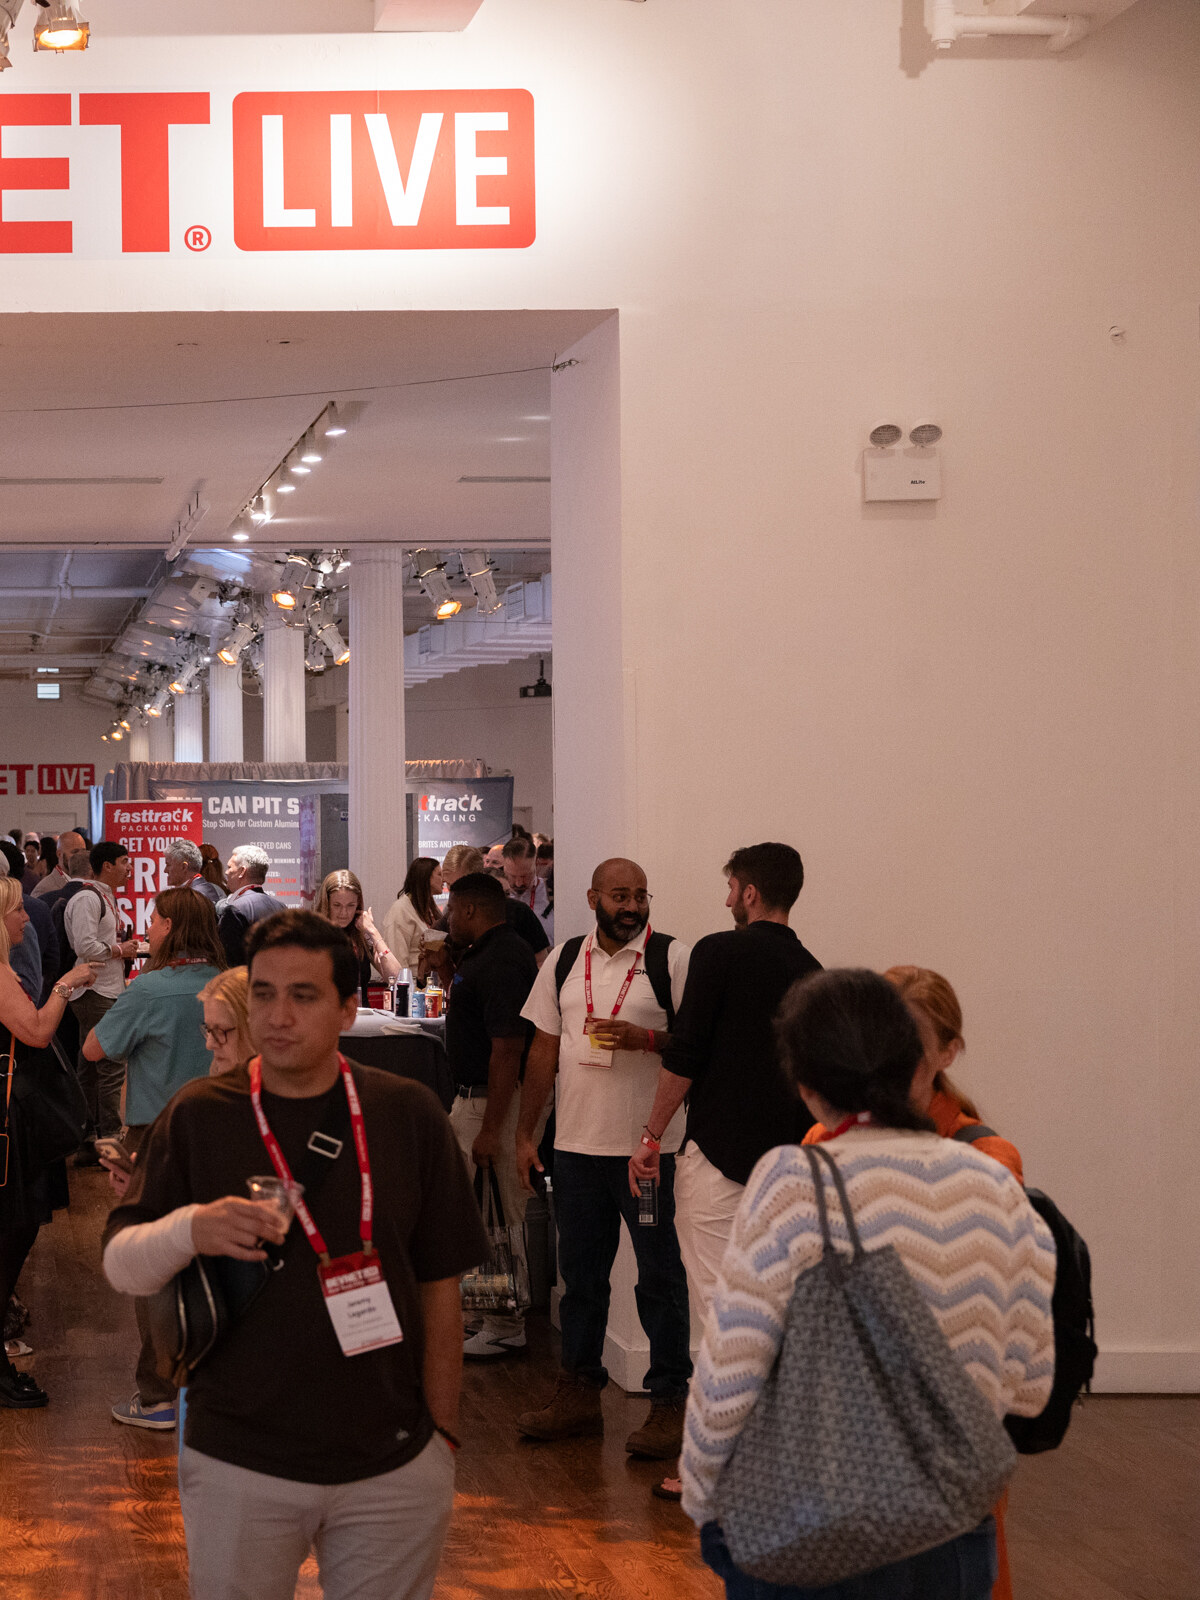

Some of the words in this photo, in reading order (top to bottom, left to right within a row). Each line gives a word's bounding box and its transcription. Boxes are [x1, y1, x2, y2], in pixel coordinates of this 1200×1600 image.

[261, 110, 512, 229] LIVE
[43, 767, 91, 791] LIVE
[208, 796, 246, 815] CAN
[252, 796, 282, 815] PIT
[287, 797, 299, 815] S
[114, 808, 193, 823] fasttrack
[202, 819, 218, 829] Stop
[219, 819, 235, 829] Shop
[237, 819, 246, 828] for
[248, 819, 273, 828] Custom
[119, 837, 142, 852] GET
[148, 836, 185, 852] YOU
[276, 841, 292, 850] CANS
[439, 840, 452, 848] AND
